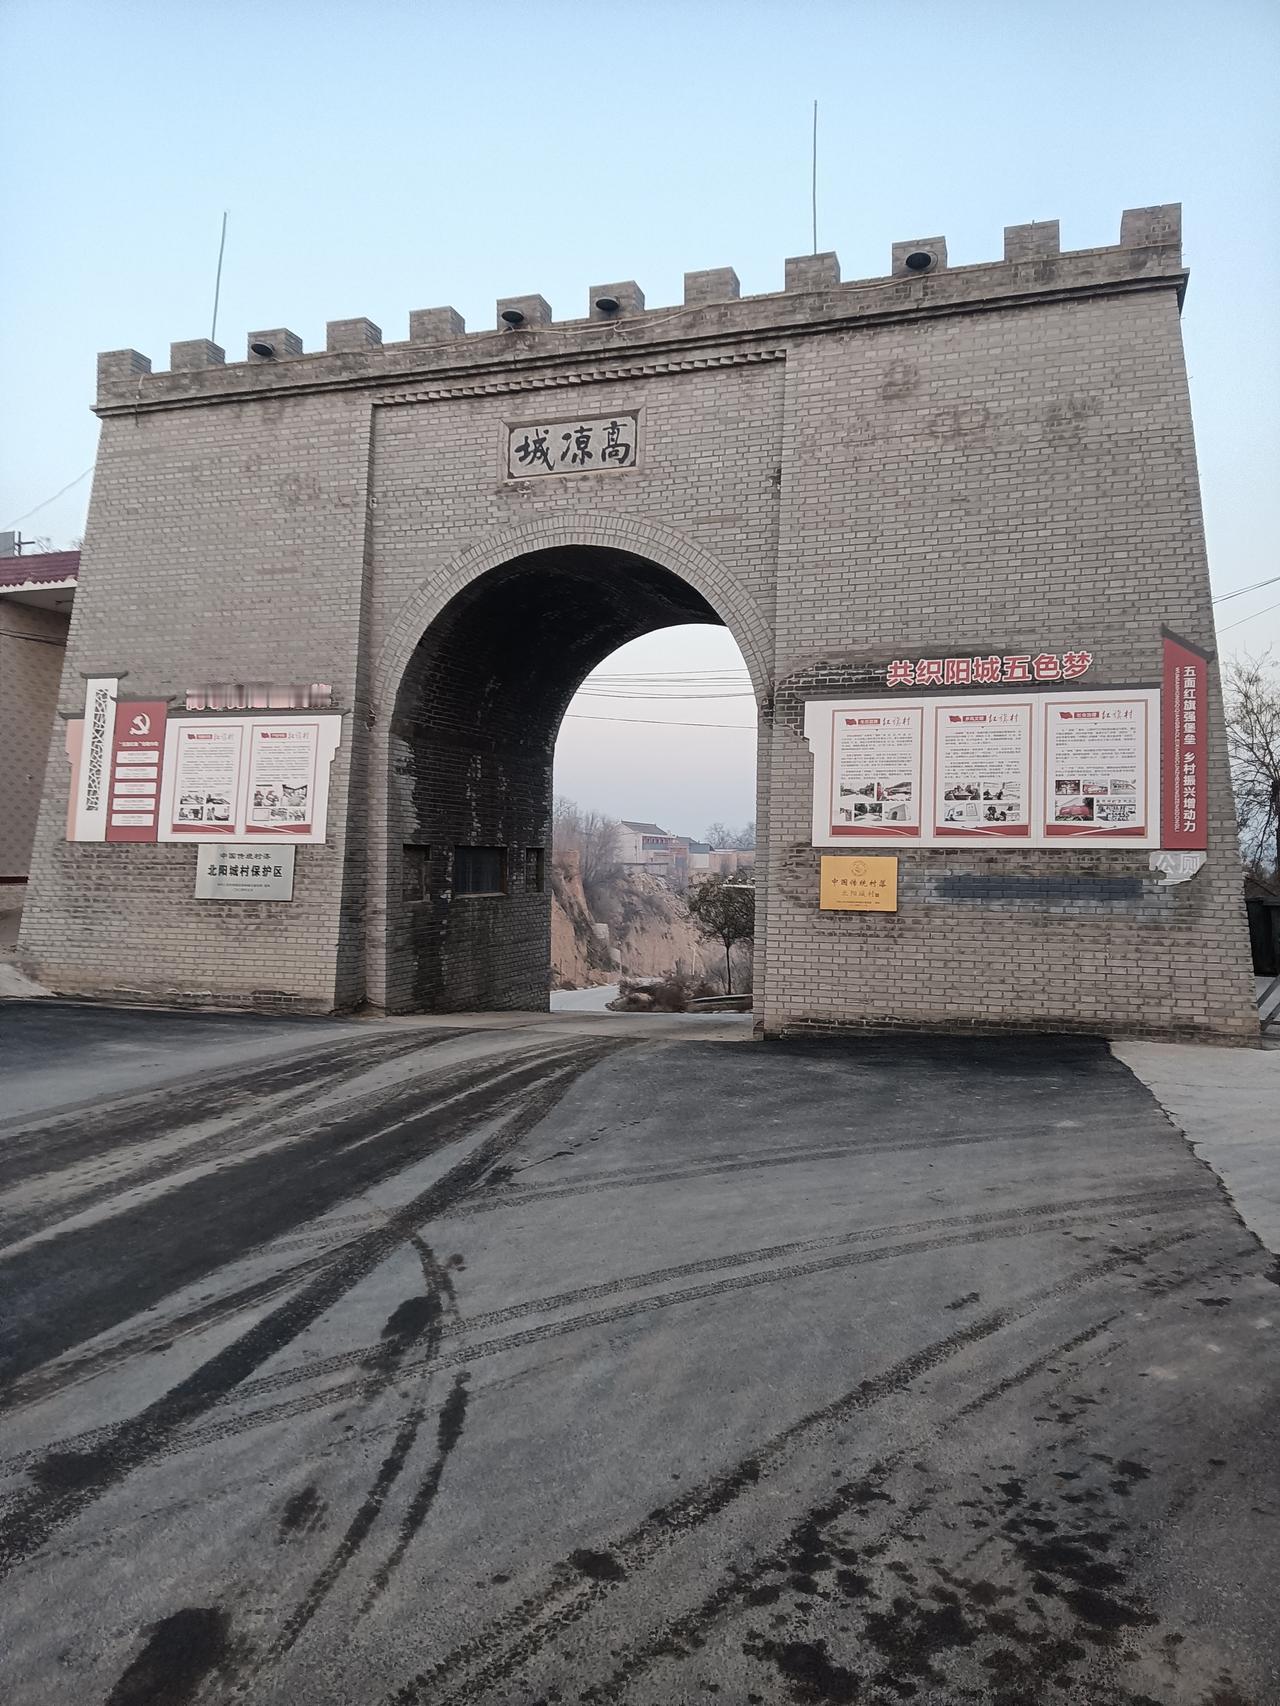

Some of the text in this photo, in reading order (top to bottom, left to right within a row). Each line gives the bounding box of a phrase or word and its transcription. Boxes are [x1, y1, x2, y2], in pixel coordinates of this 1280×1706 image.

[887, 651, 1093, 687] 共织阳城五色梦
[1183, 665, 1197, 832] 五面红旗强堡垒 乡村振兴增动力
[207, 864, 283, 878] 北阳城村保护区
[831, 877, 887, 889] 中国传统村落
